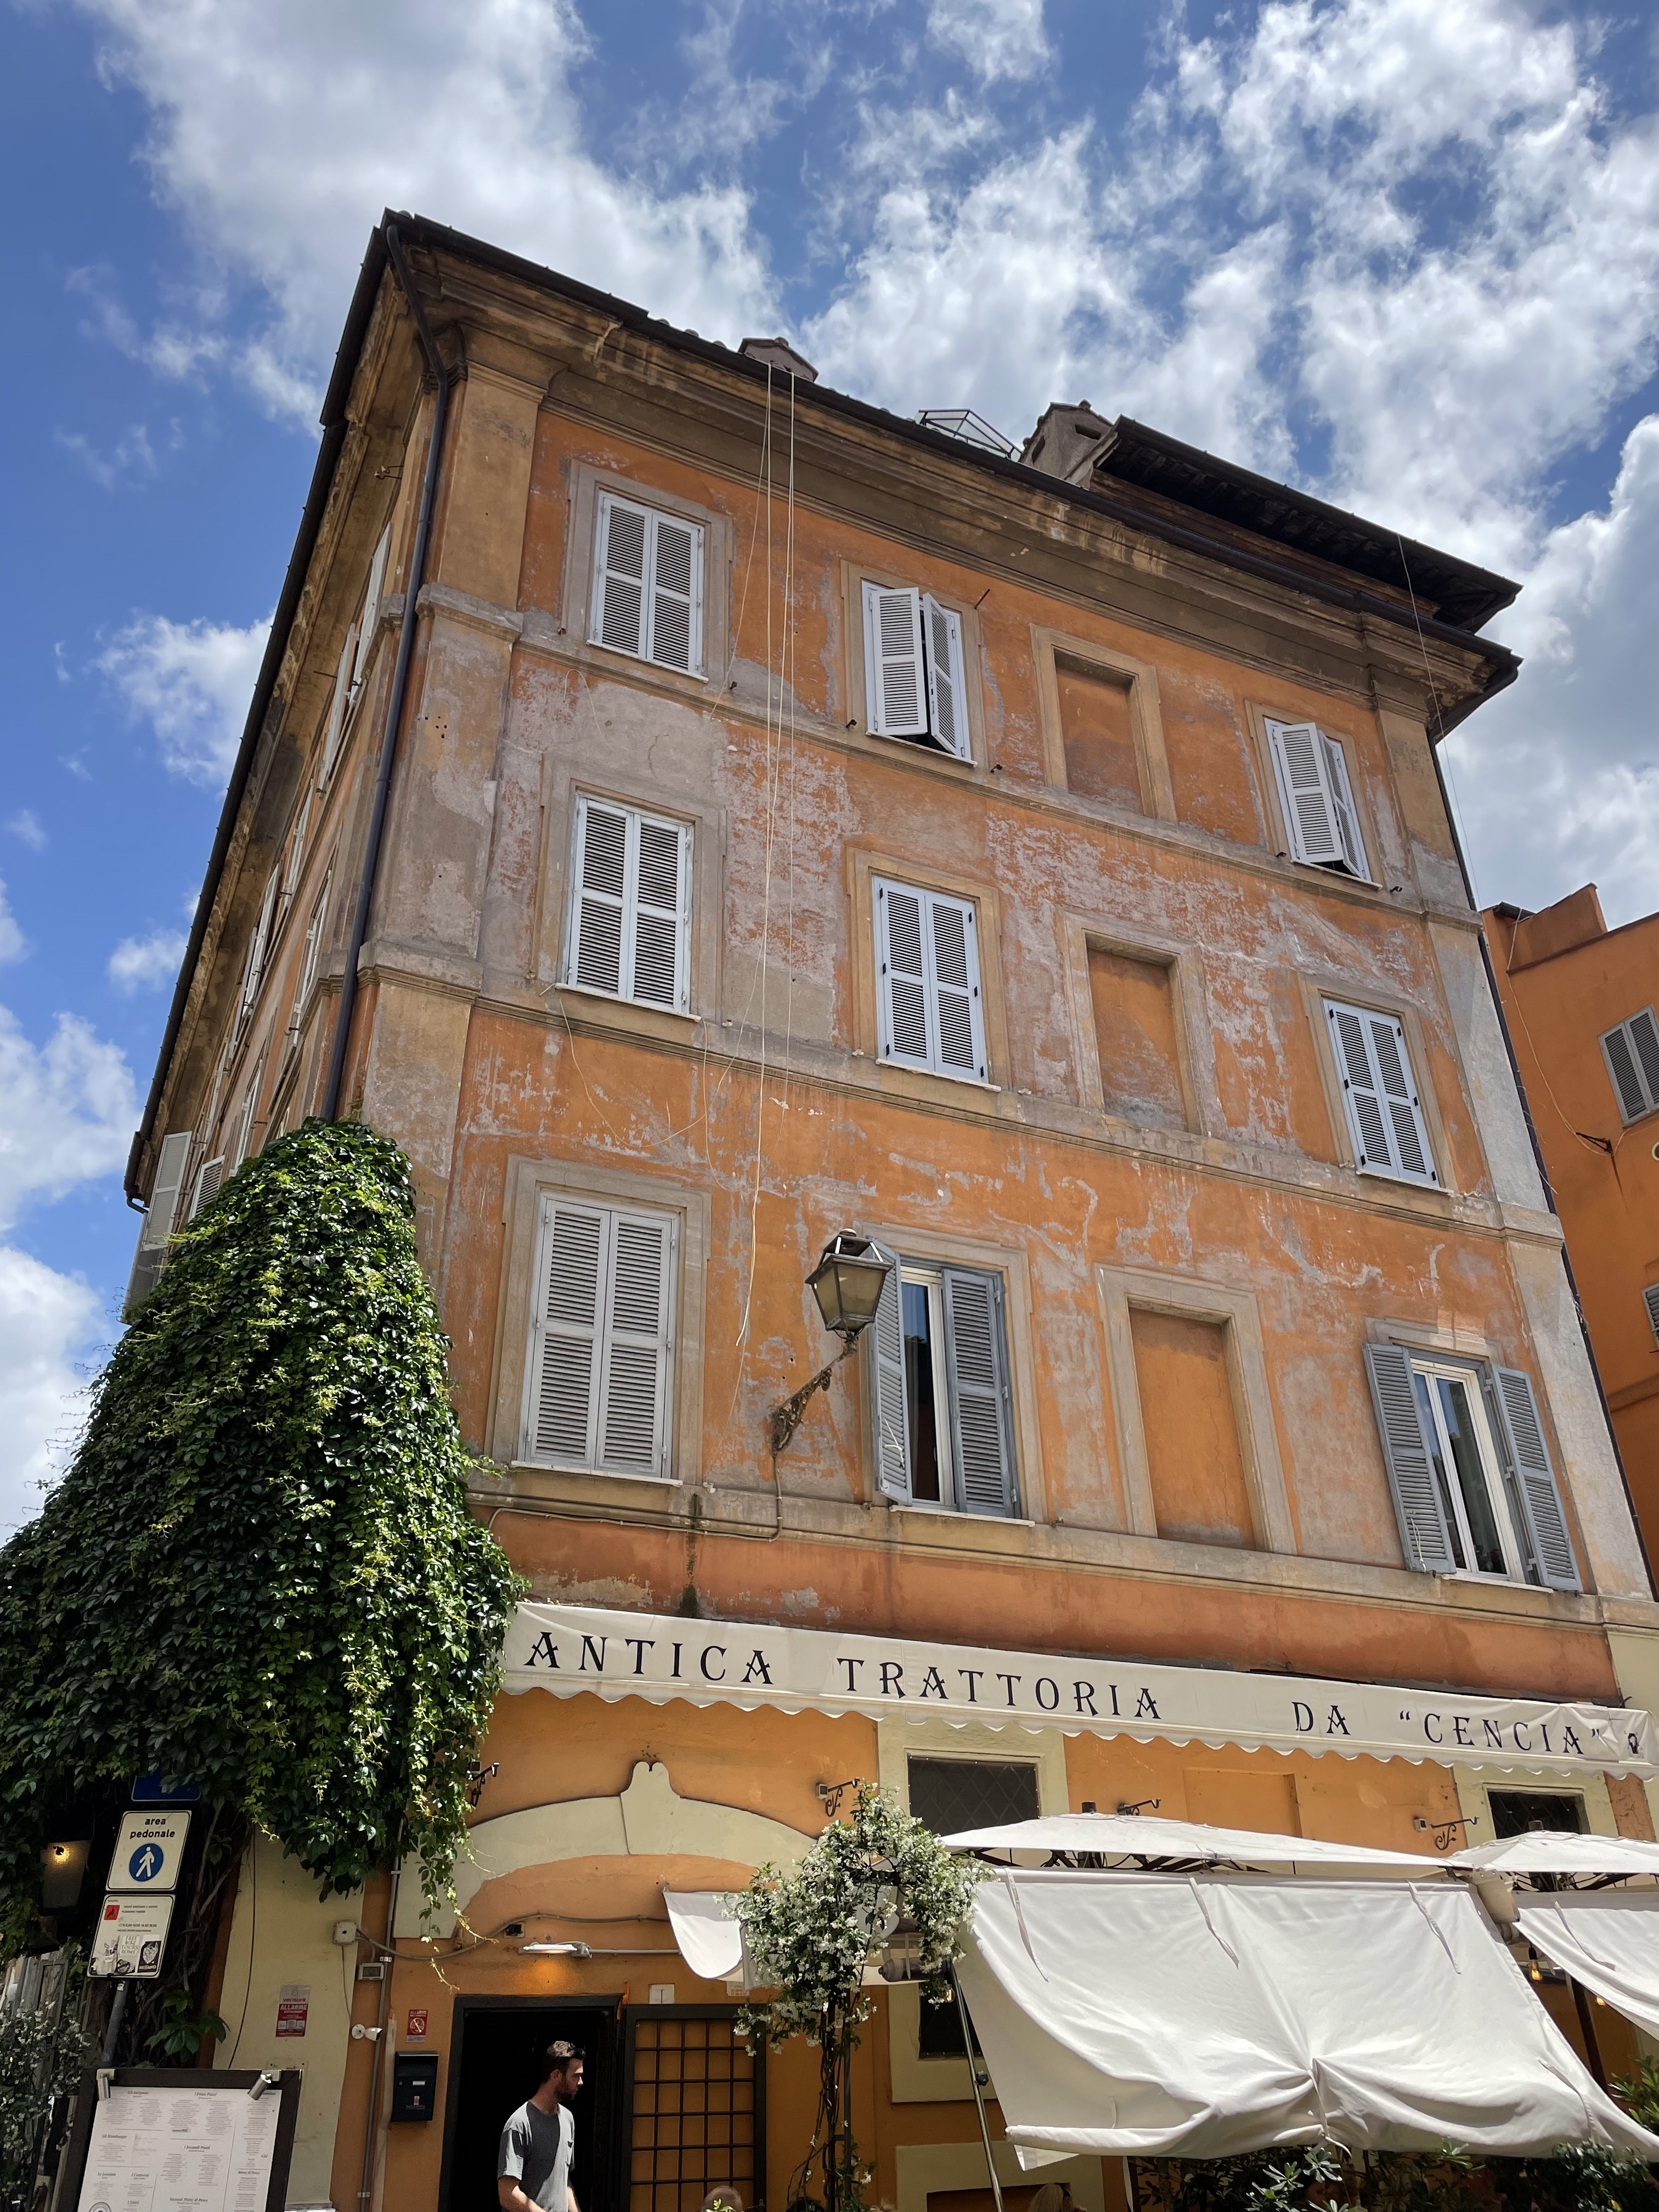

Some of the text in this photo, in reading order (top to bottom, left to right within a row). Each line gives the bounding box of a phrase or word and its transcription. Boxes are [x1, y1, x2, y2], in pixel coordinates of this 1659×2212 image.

[523, 1632, 774, 1685] ANTICA
[837, 1658, 1162, 1720] TRATTORIA
[1291, 1701, 1351, 1735] DA
[129, 1829, 176, 1839] pedonale
